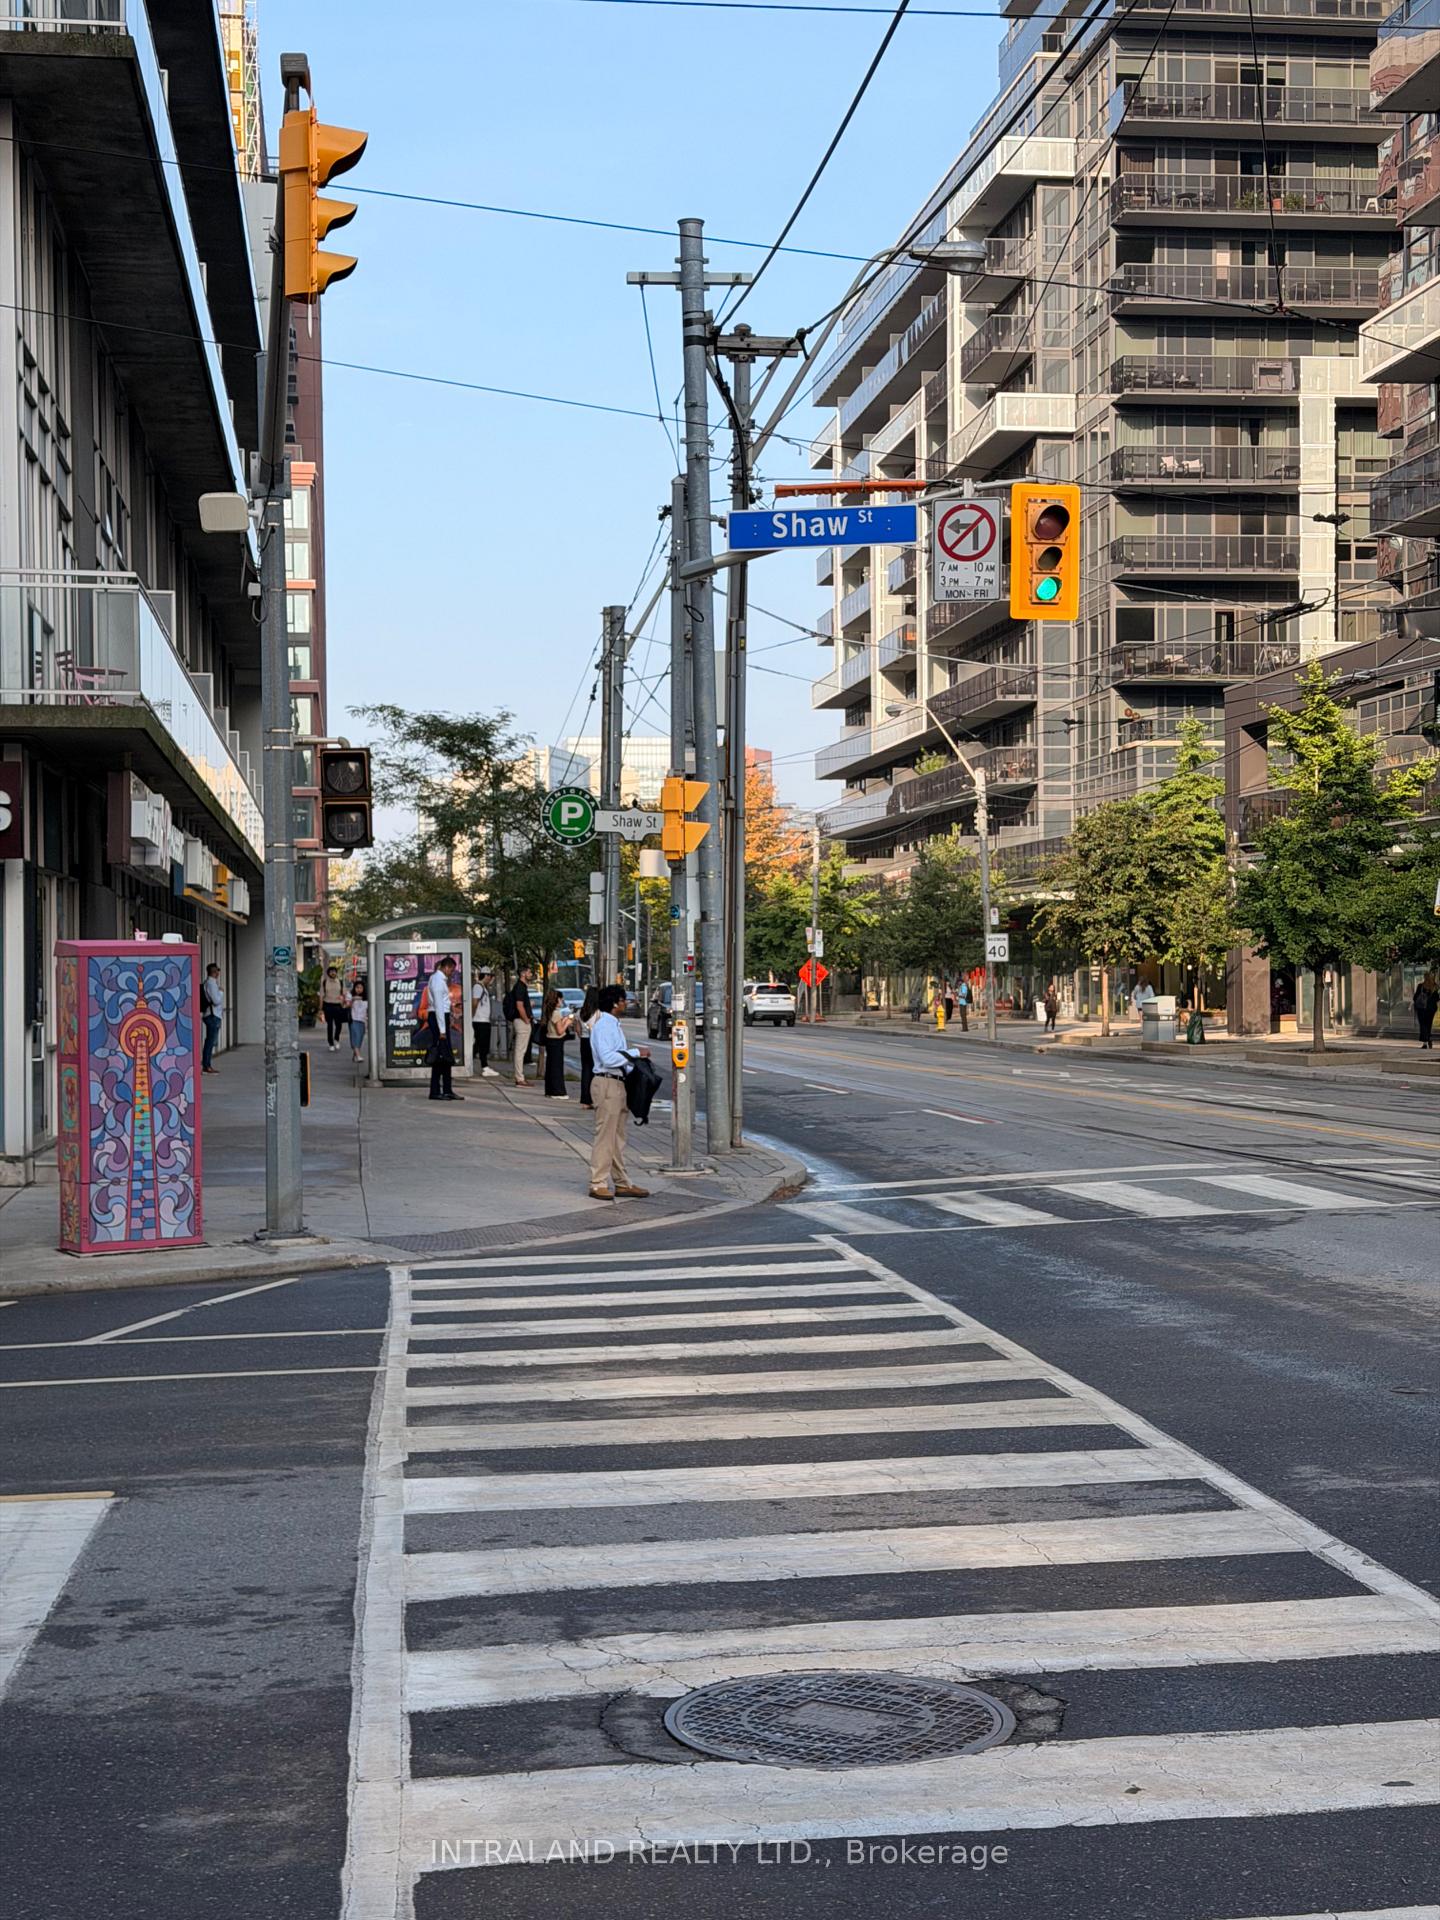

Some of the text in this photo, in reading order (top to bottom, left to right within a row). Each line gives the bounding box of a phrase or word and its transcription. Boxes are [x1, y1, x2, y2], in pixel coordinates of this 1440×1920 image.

[772, 509, 873, 539] Shaw St
[940, 561, 946, 572] 7
[974, 562, 984, 572] 10
[985, 564, 995, 572] AM
[940, 576, 946, 586] 3
[949, 578, 959, 586] PM
[975, 576, 981, 586] 7
[984, 578, 993, 586] PM
[561, 801, 584, 825] P
[612, 814, 657, 828] Shaw St
[988, 945, 1007, 958] 40
[390, 979, 416, 991] Find
[389, 991, 417, 1004] your
[393, 1001, 413, 1015] fun
